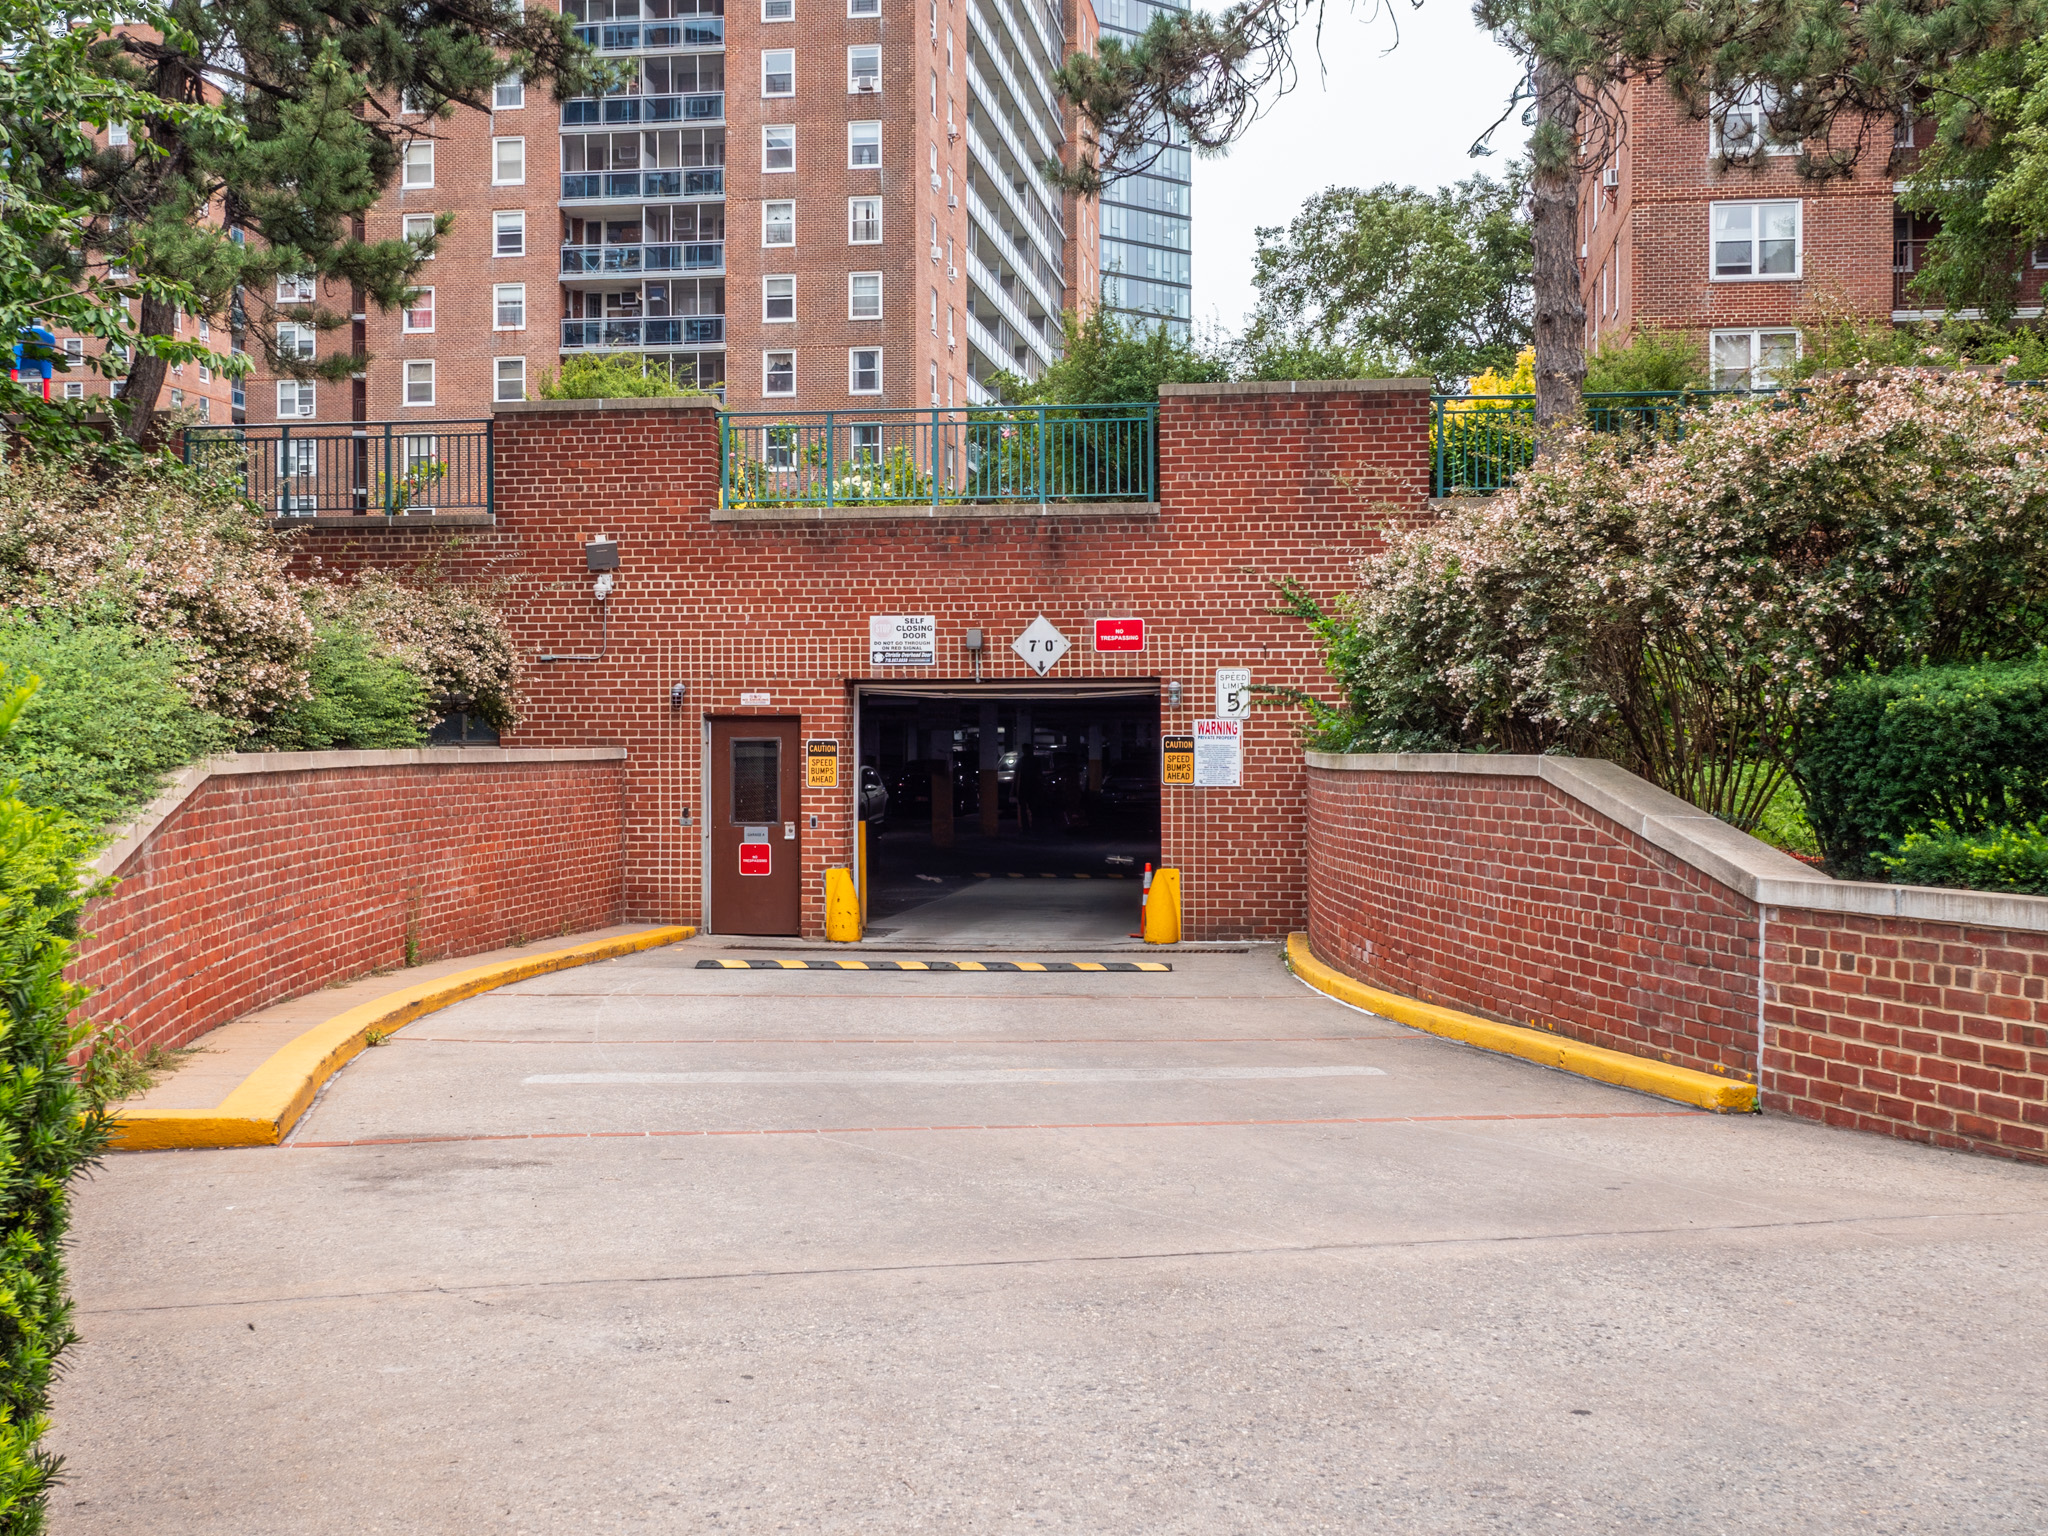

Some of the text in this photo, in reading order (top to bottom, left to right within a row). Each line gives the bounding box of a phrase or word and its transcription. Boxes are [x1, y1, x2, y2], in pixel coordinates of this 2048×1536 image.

[1227, 693, 1240, 712] 5
[1198, 721, 1238, 735] WARNING
[1167, 755, 1190, 763] SPEED
[1167, 772, 1190, 780] AHEAD
